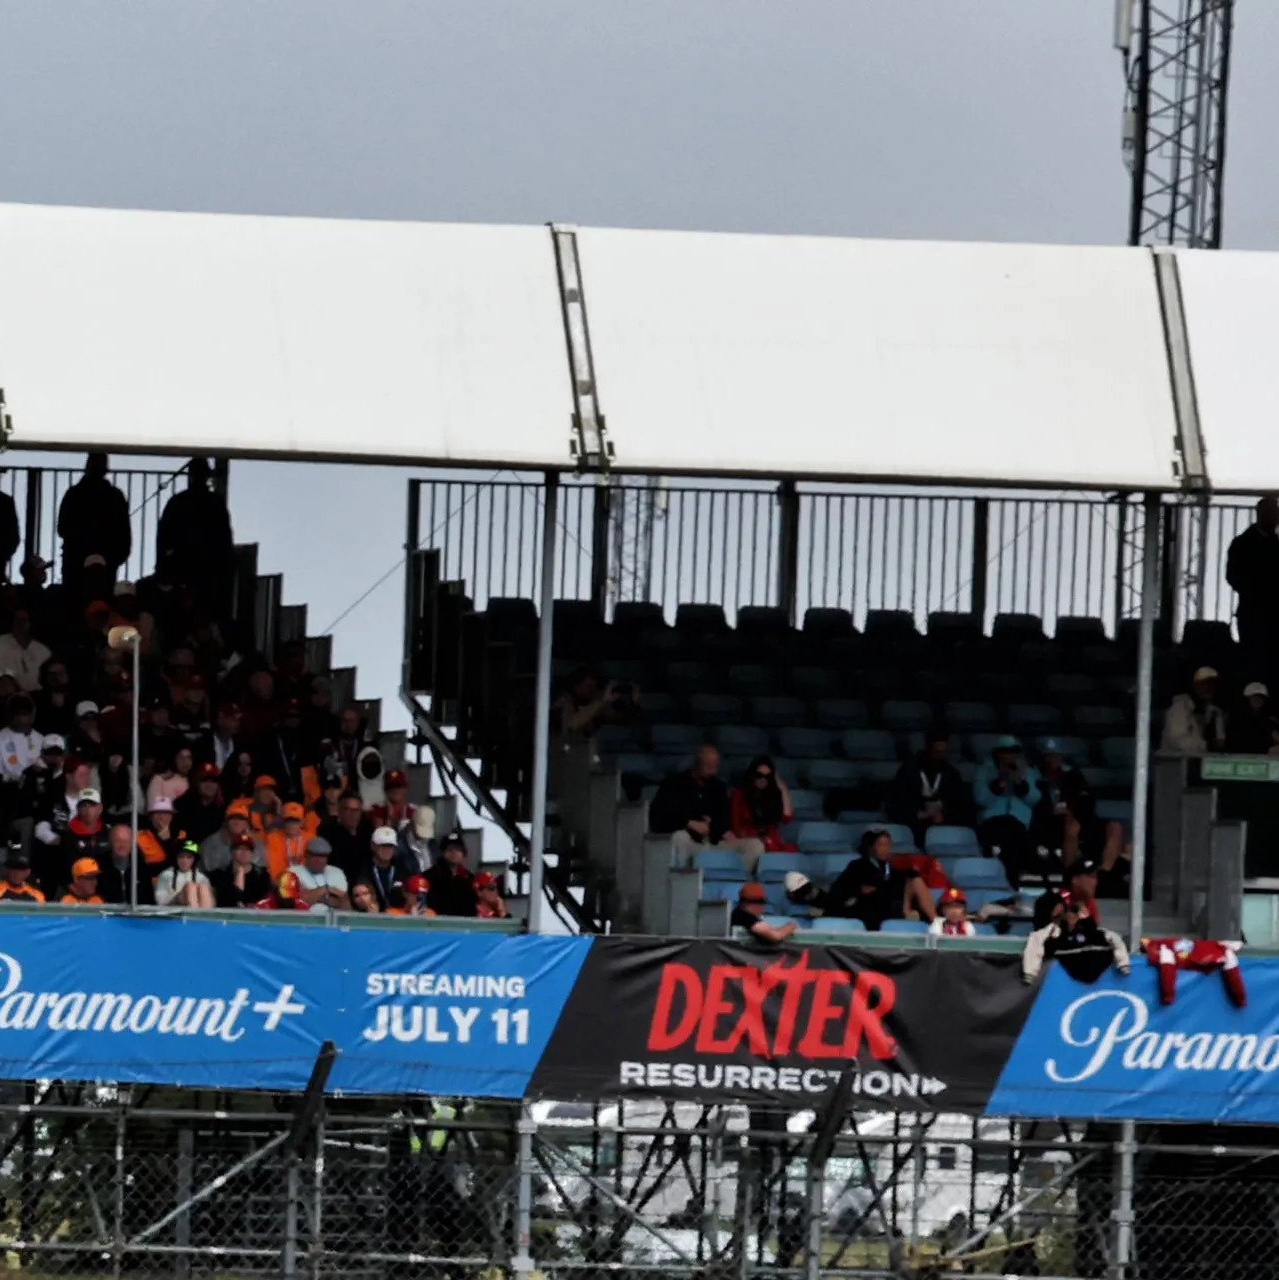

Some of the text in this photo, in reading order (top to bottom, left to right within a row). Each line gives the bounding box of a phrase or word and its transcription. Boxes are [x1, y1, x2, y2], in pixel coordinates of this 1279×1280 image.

[367, 973, 525, 999] STREAMING
[647, 950, 897, 1060] DEXTER
[363, 1007, 529, 1044] JULY 11
